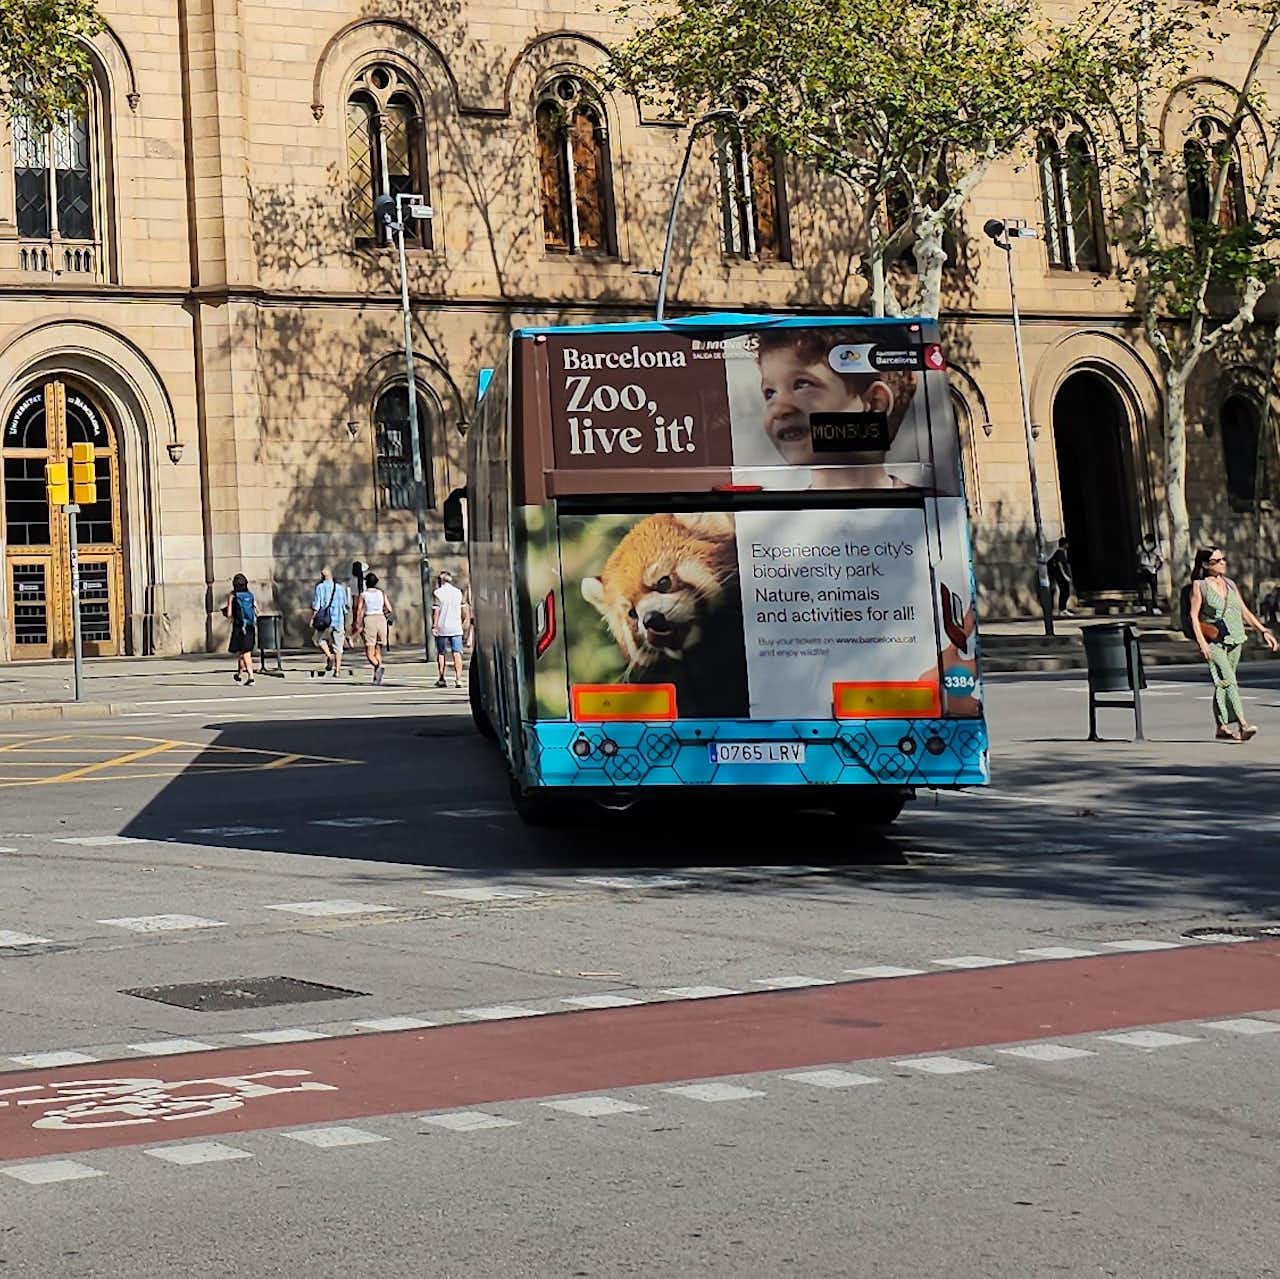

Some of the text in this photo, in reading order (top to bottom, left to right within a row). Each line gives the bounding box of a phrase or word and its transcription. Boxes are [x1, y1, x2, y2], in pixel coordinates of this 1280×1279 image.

[561, 346, 688, 370] Barcelona
[565, 376, 658, 417] Zoo,
[568, 416, 695, 455] live it!
[752, 541, 914, 560] Experience the city's
[753, 562, 885, 580] biodiversity park.
[755, 586, 880, 603] Nature, animals
[757, 606, 915, 622] and activities for all!
[944, 676, 974, 688] 3384
[720, 744, 801, 761] 0765 LRV
